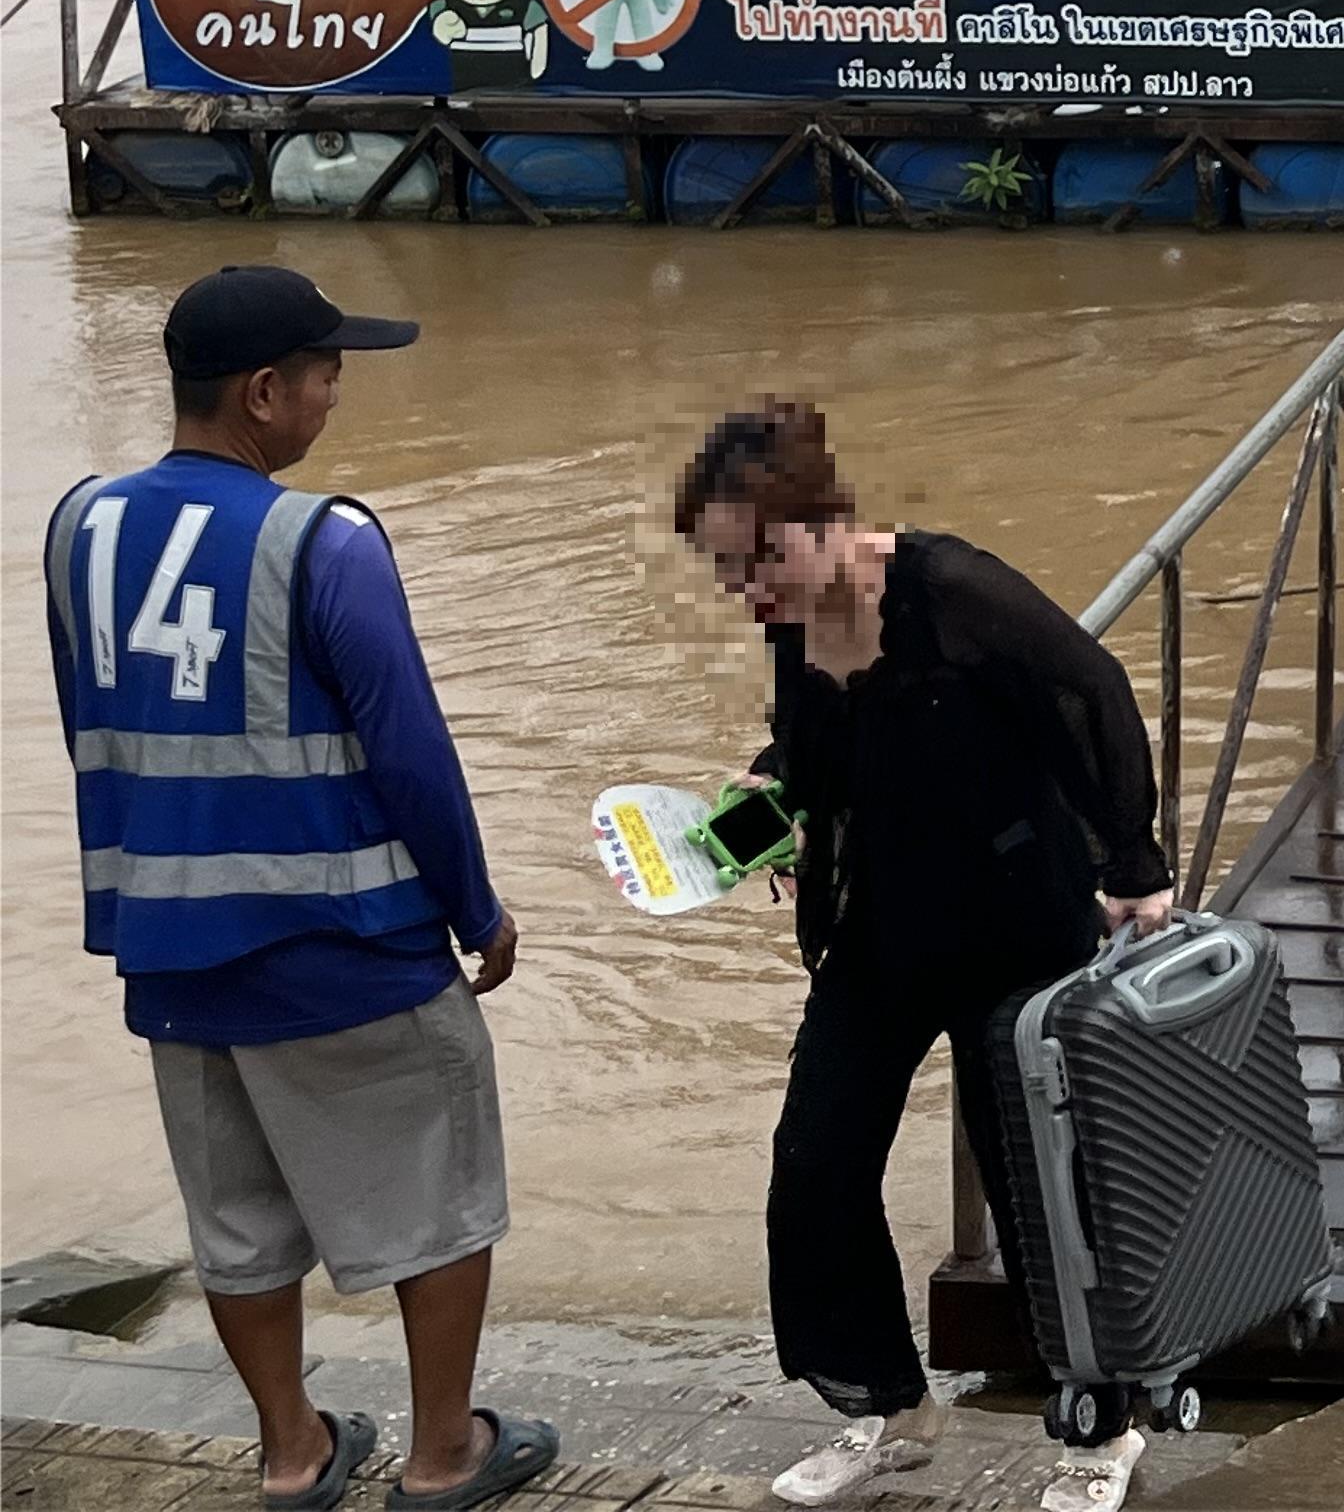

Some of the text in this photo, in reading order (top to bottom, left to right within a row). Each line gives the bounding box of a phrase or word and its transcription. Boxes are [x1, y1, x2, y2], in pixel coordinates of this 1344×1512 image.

[957, 6, 1058, 44] คาสิโน
[837, 53, 1254, 98] เมืองต้นผึ้ง แขวงบ่อแก้ว สปป.ลาว
[82, 497, 227, 702] 14
